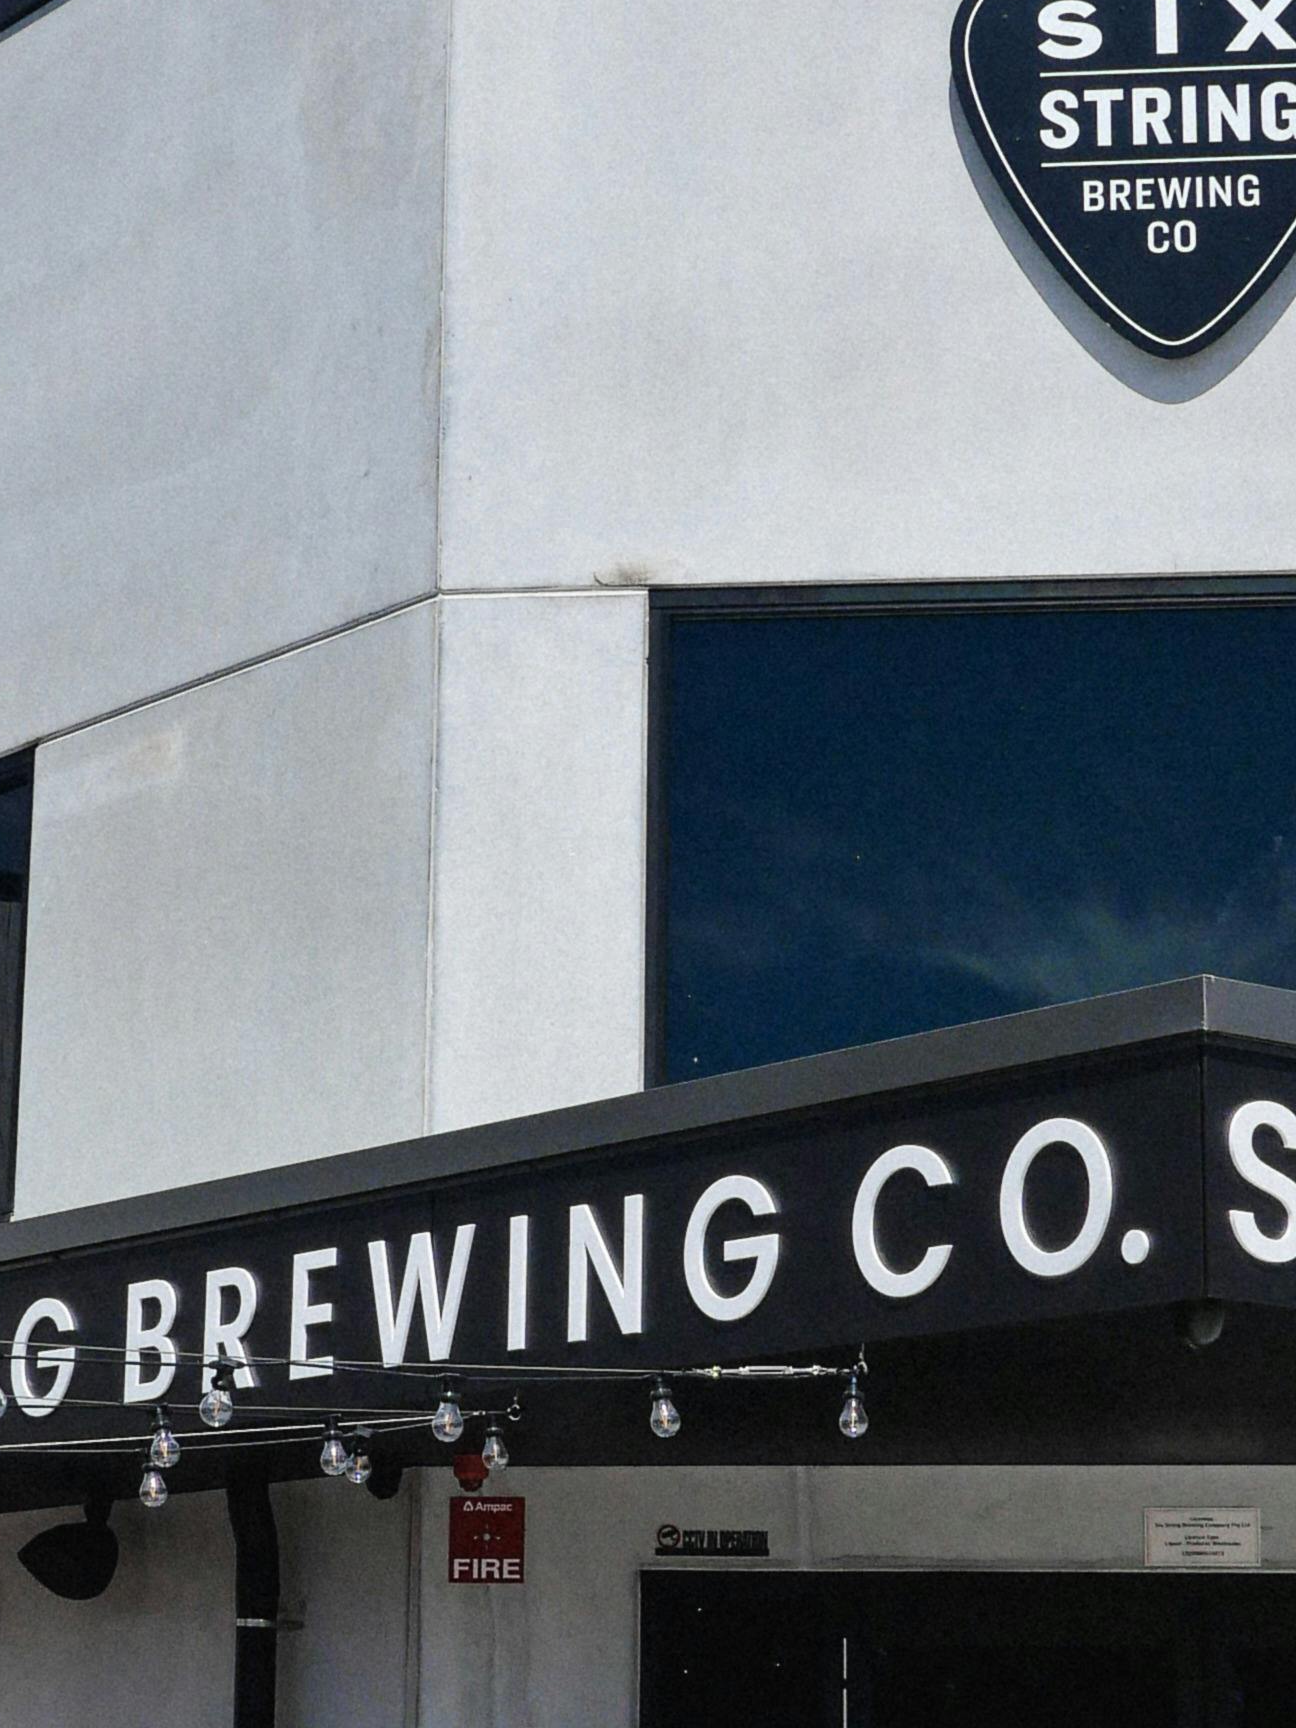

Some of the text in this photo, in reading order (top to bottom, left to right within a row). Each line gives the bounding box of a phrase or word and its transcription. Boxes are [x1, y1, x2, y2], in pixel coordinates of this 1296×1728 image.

[1082, 173, 1261, 212] BREWING
[1147, 219, 1197, 254] CO
[123, 1174, 781, 1405] BREWING
[851, 1117, 1151, 1298] CO.
[475, 1501, 513, 1513] Ampac
[453, 1558, 522, 1580] FIRE
